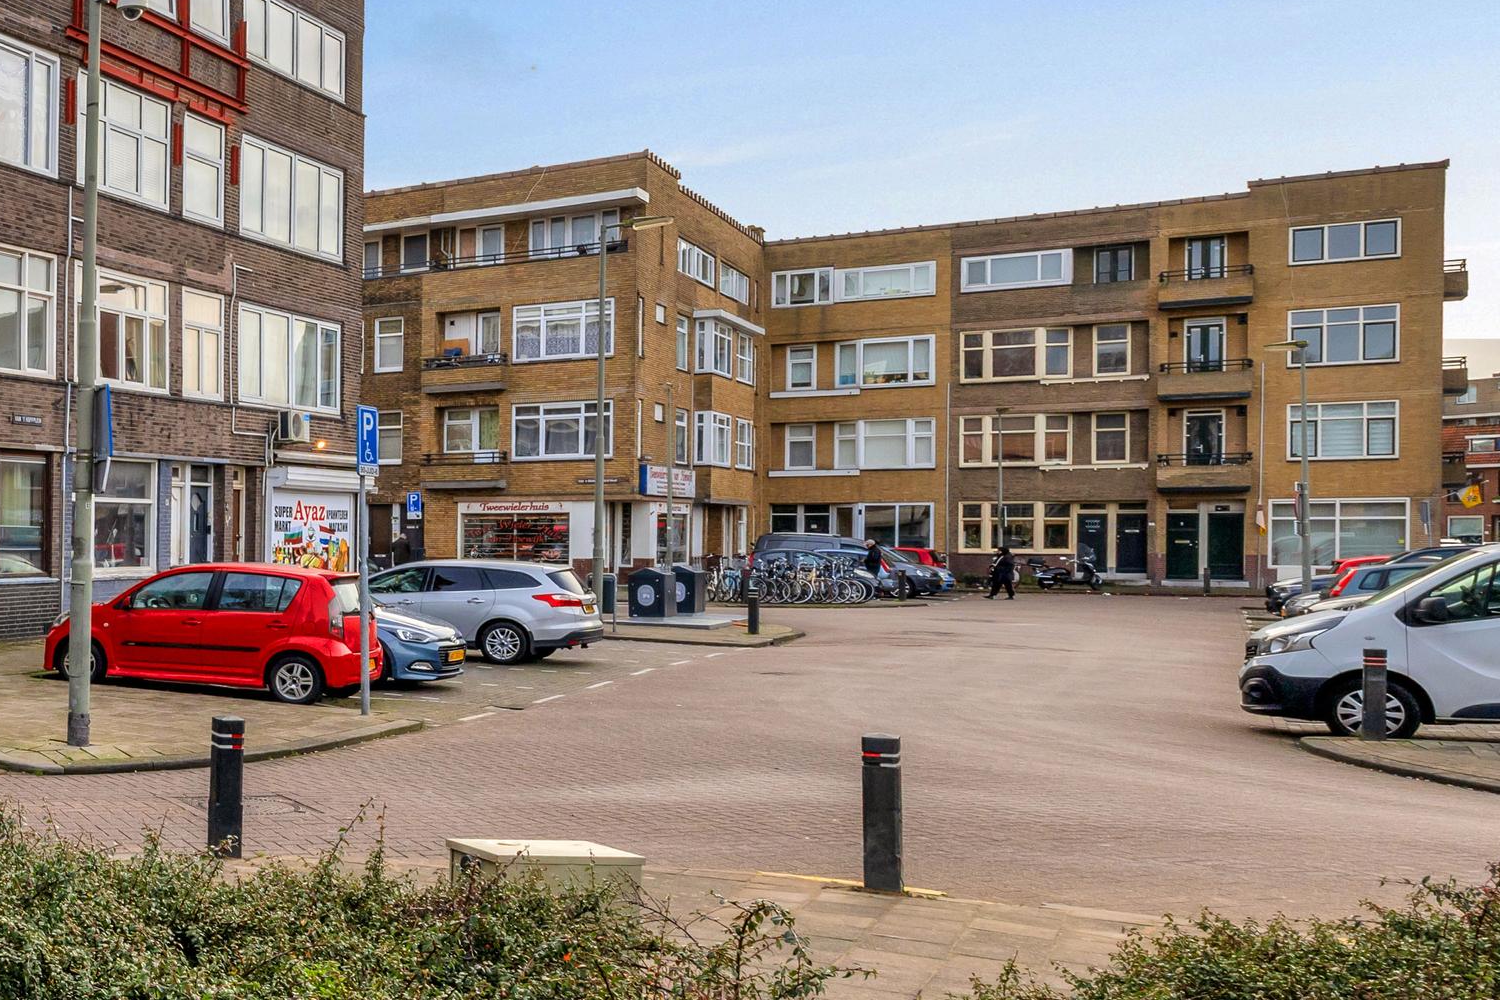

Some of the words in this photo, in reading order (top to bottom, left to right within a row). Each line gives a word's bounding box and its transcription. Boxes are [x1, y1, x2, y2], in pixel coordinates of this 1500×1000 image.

[363, 411, 374, 441] P
[410, 494, 418, 505] P
[274, 506, 293, 518] SUPER
[480, 502, 549, 512] Tweewielerhuis
[293, 500, 326, 527] Ayaz
[274, 520, 291, 532] MARKT
